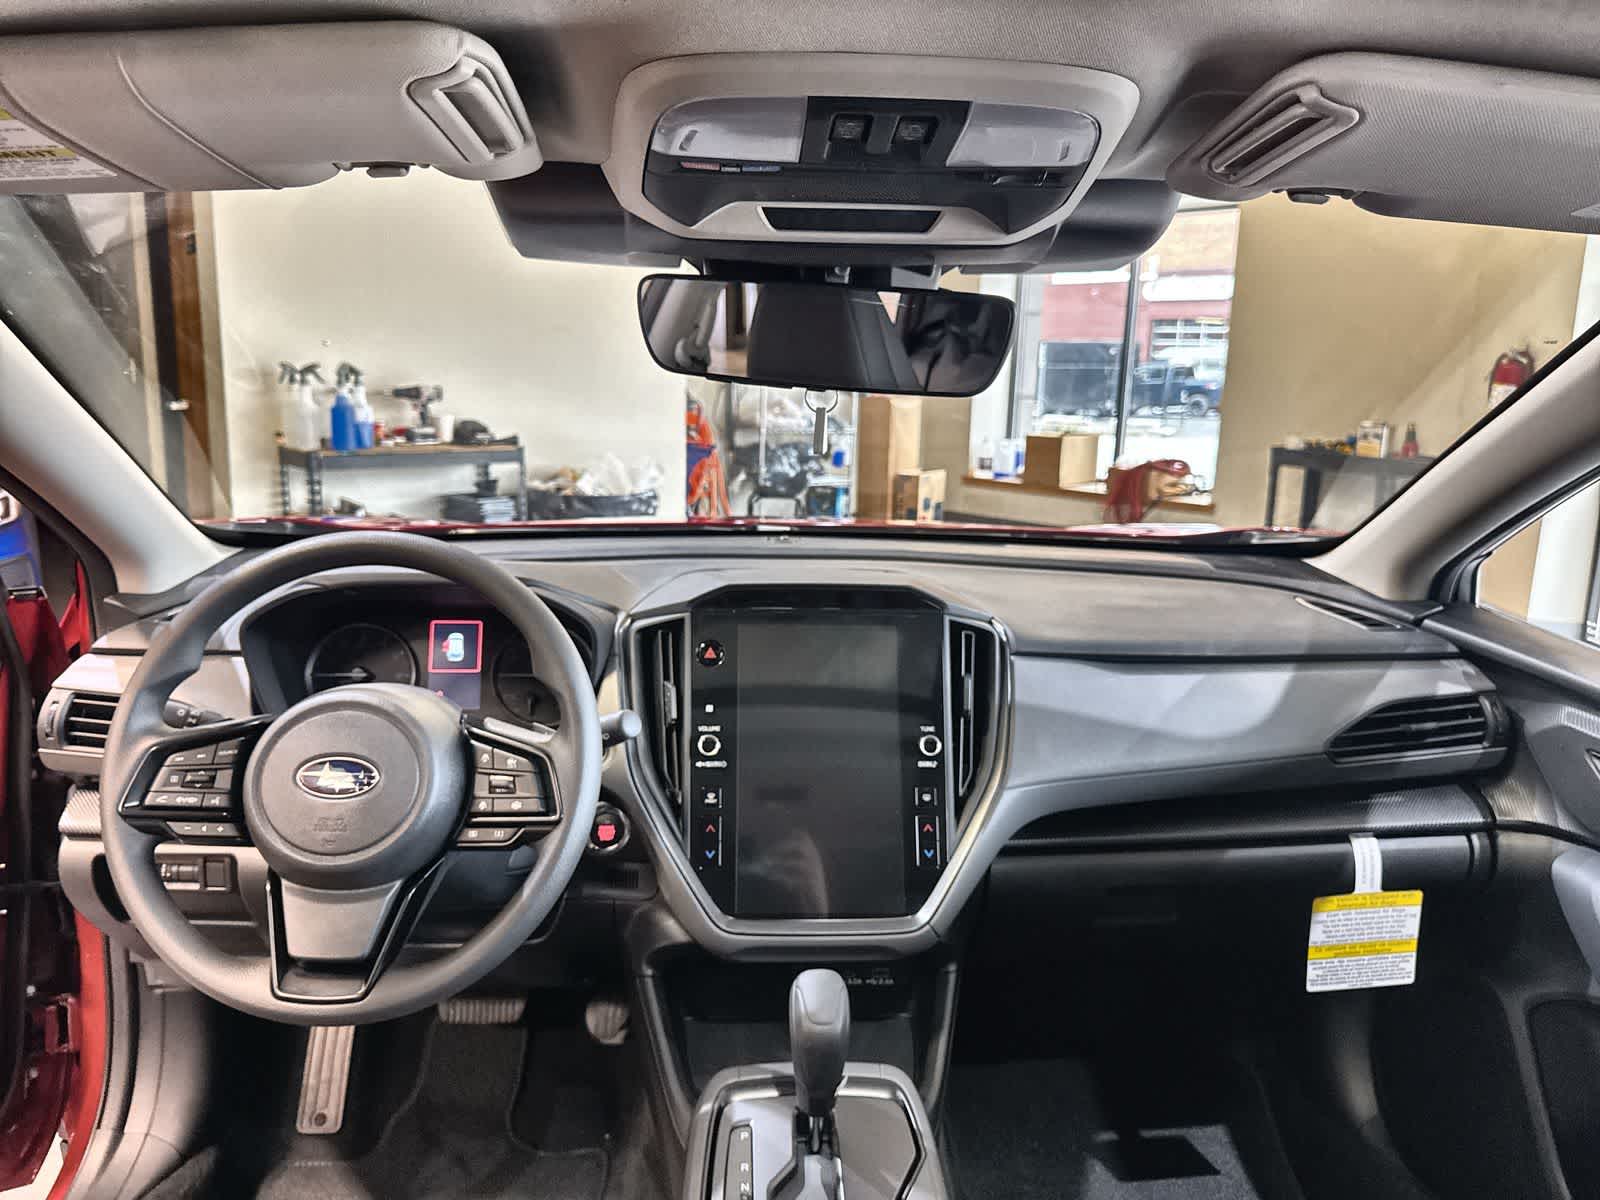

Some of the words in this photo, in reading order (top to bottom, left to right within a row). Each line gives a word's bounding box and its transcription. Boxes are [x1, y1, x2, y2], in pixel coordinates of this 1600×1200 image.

[740, 1131, 749, 1141] P
[740, 1162, 749, 1171] R
[740, 1182, 750, 1192] N
